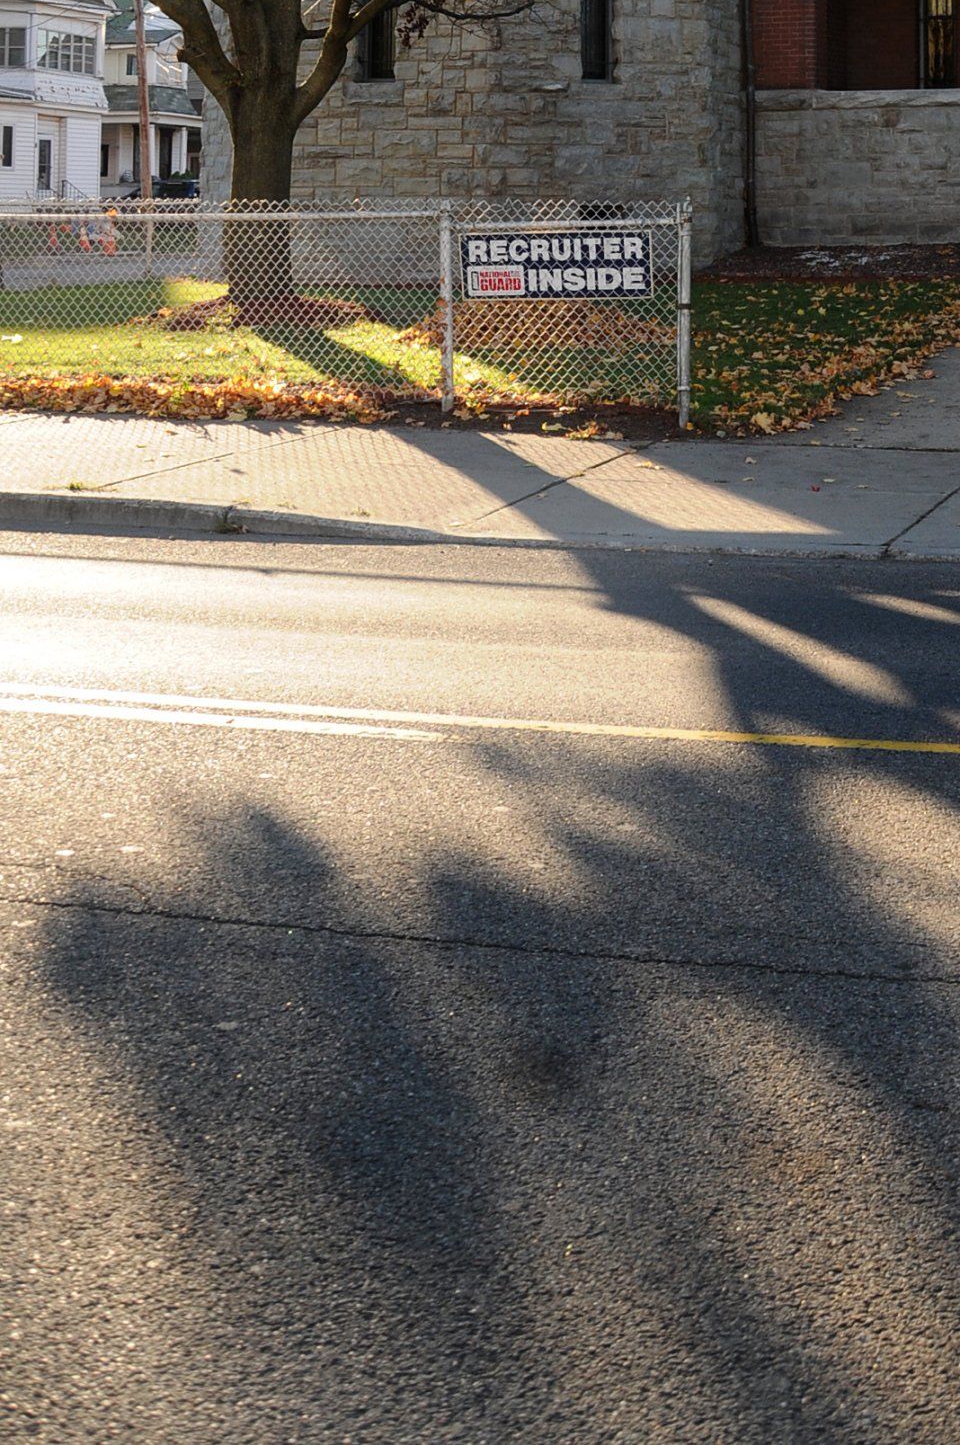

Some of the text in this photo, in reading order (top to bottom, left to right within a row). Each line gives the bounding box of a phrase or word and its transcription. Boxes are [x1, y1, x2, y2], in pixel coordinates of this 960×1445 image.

[467, 236, 643, 263] RECRUITER
[480, 277, 521, 291] GUARD
[527, 267, 647, 292] INSIDE
